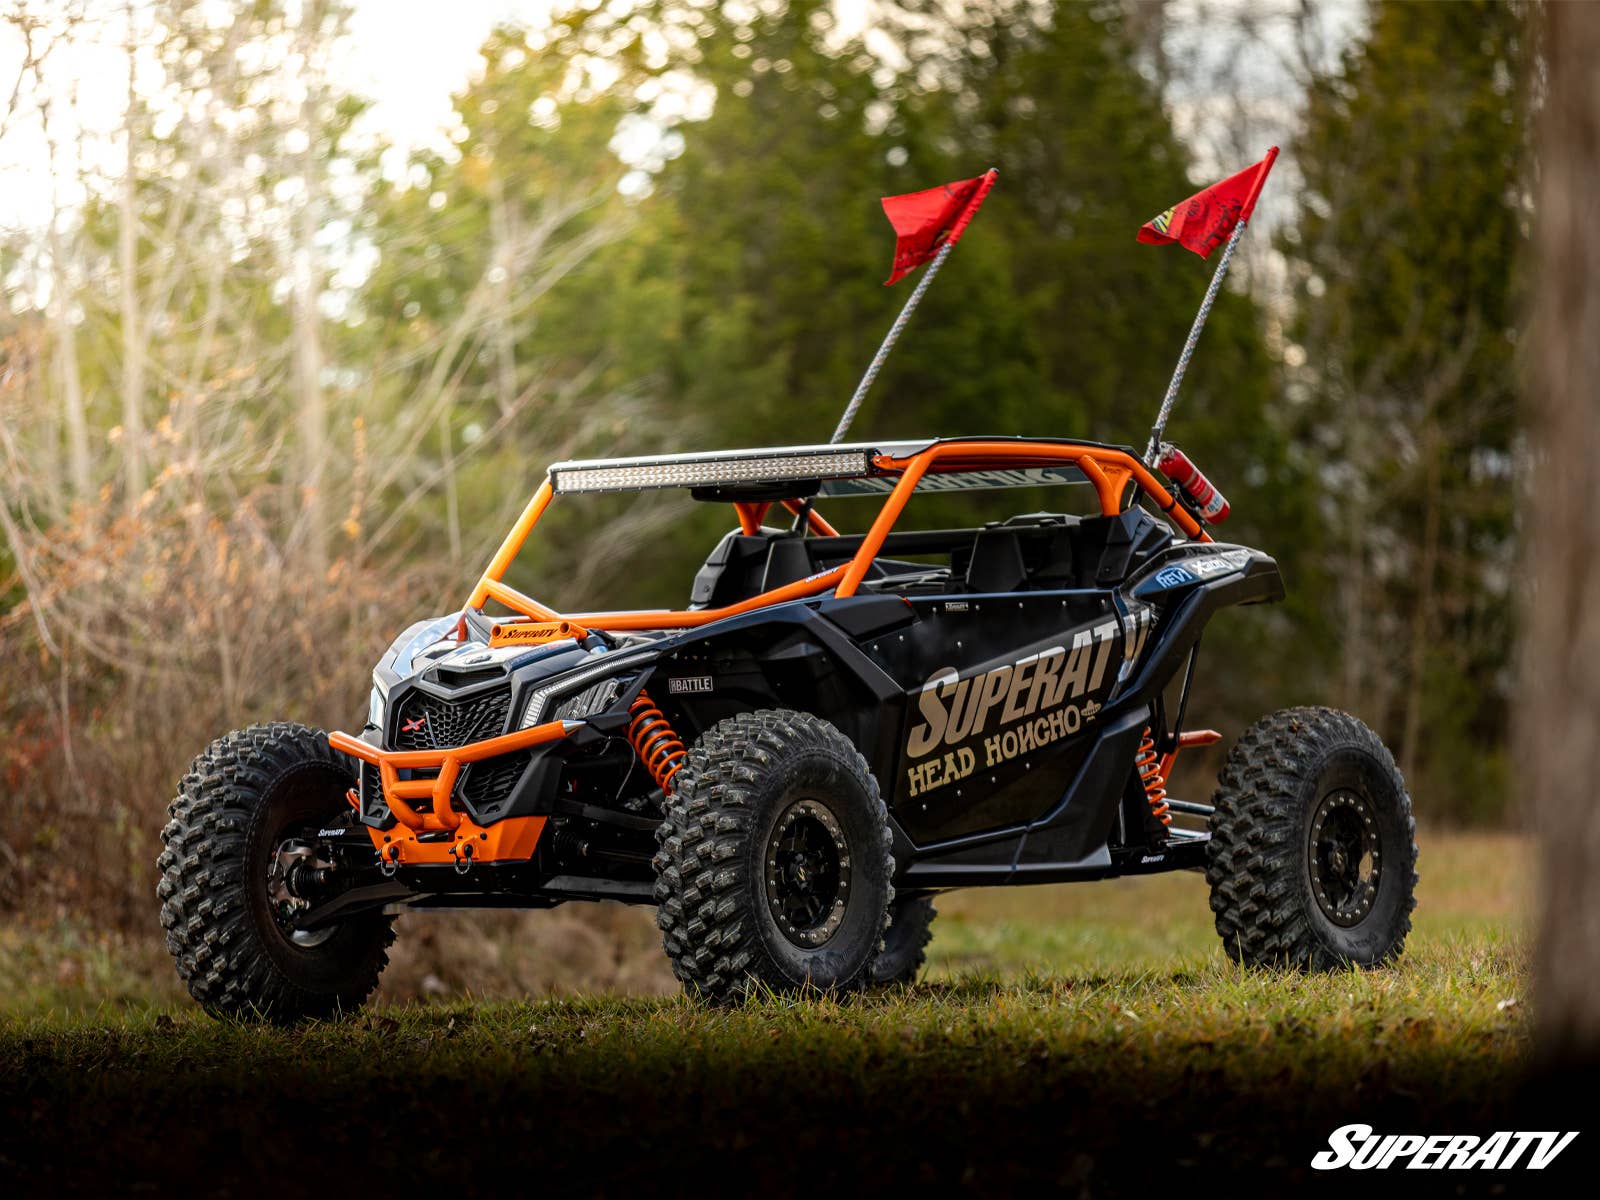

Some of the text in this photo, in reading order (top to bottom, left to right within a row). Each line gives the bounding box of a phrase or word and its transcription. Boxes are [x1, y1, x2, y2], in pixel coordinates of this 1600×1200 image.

[907, 608, 1151, 758] SUPERATV
[907, 705, 1081, 797] HEAD HONCHO
